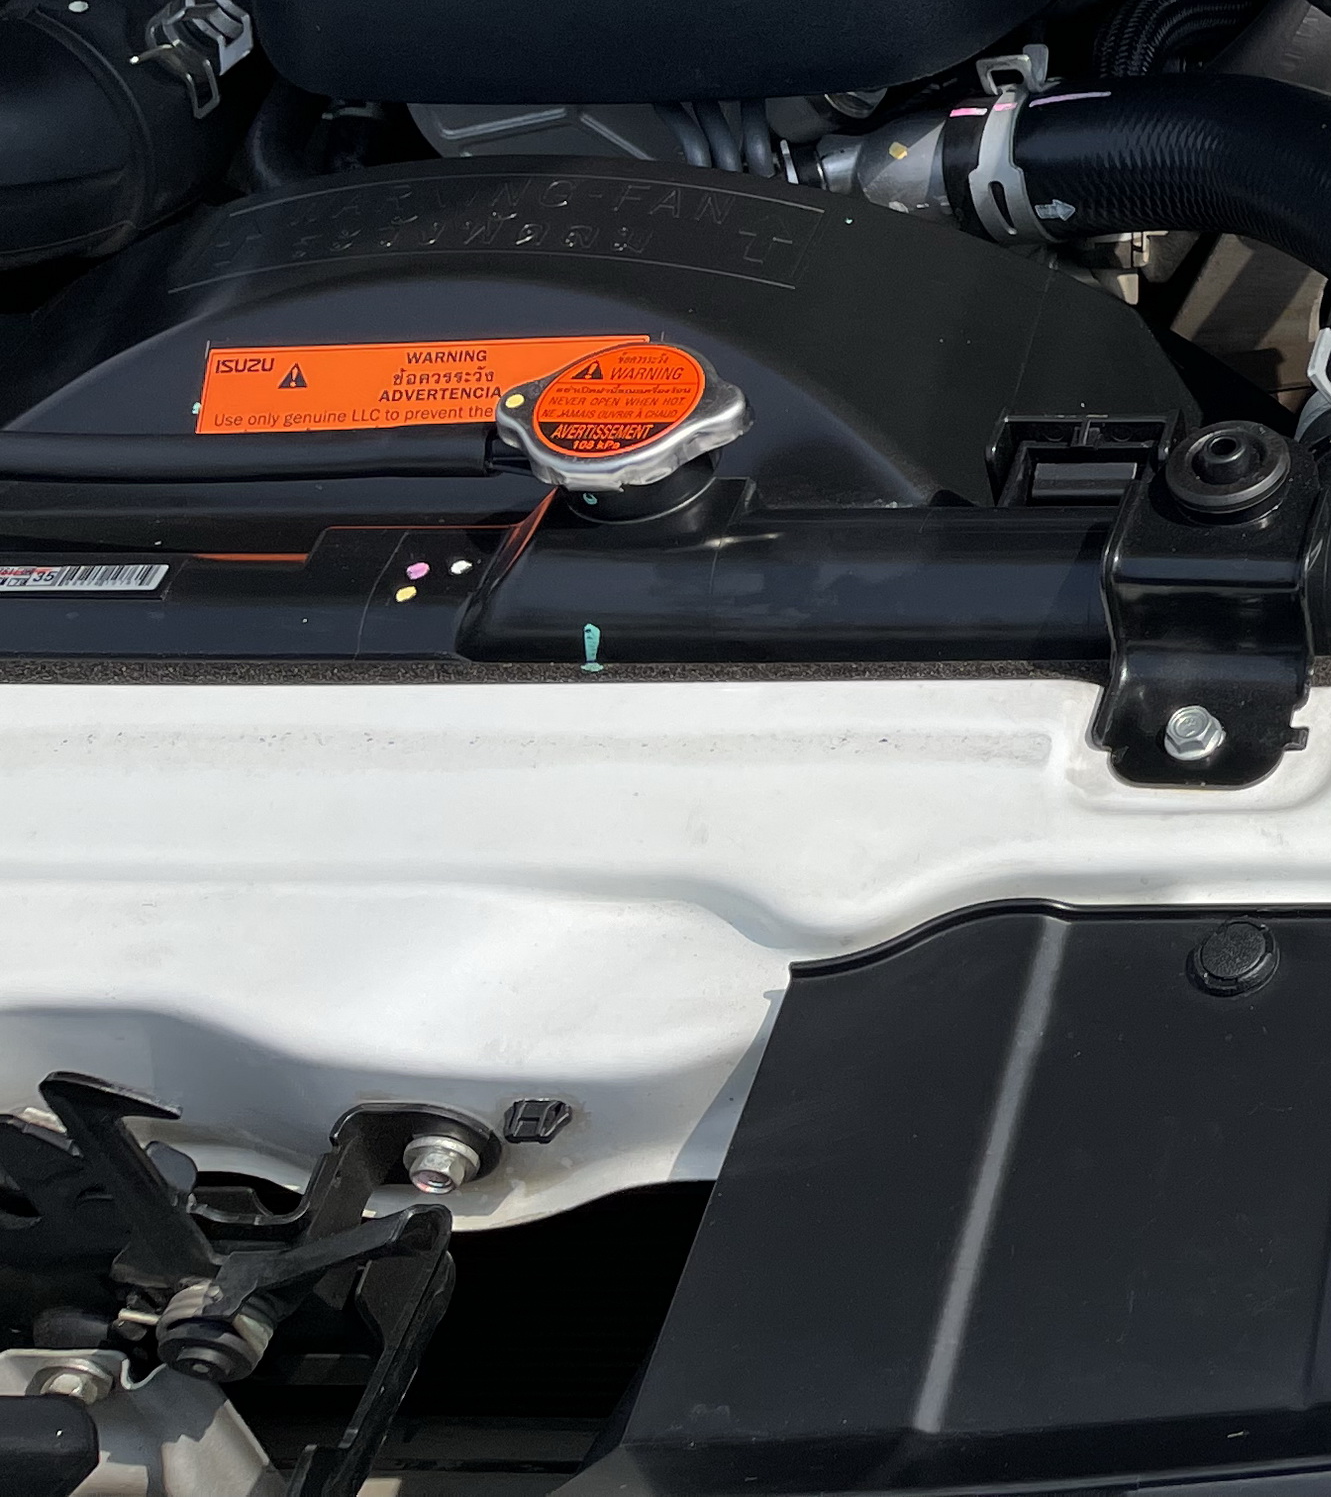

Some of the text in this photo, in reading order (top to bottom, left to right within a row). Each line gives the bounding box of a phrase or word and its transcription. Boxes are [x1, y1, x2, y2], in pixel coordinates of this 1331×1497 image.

[406, 349, 487, 365] WARNING
[215, 357, 276, 374] ISUZU
[610, 366, 685, 381] WARNING
[392, 365, 495, 386] ข้อควรระวัง
[378, 386, 502, 403] ADVERTENCIA
[550, 396, 586, 406] NEVER
[590, 396, 621, 406] OPEN
[625, 396, 659, 406] WHEN
[213, 405, 494, 429] Use only genuine LLC to prevent the
[541, 409, 556, 418] NE
[556, 409, 596, 420] JAMAIS
[550, 423, 654, 441] AVERTISSEMENT
[32, 570, 56, 583] 35
